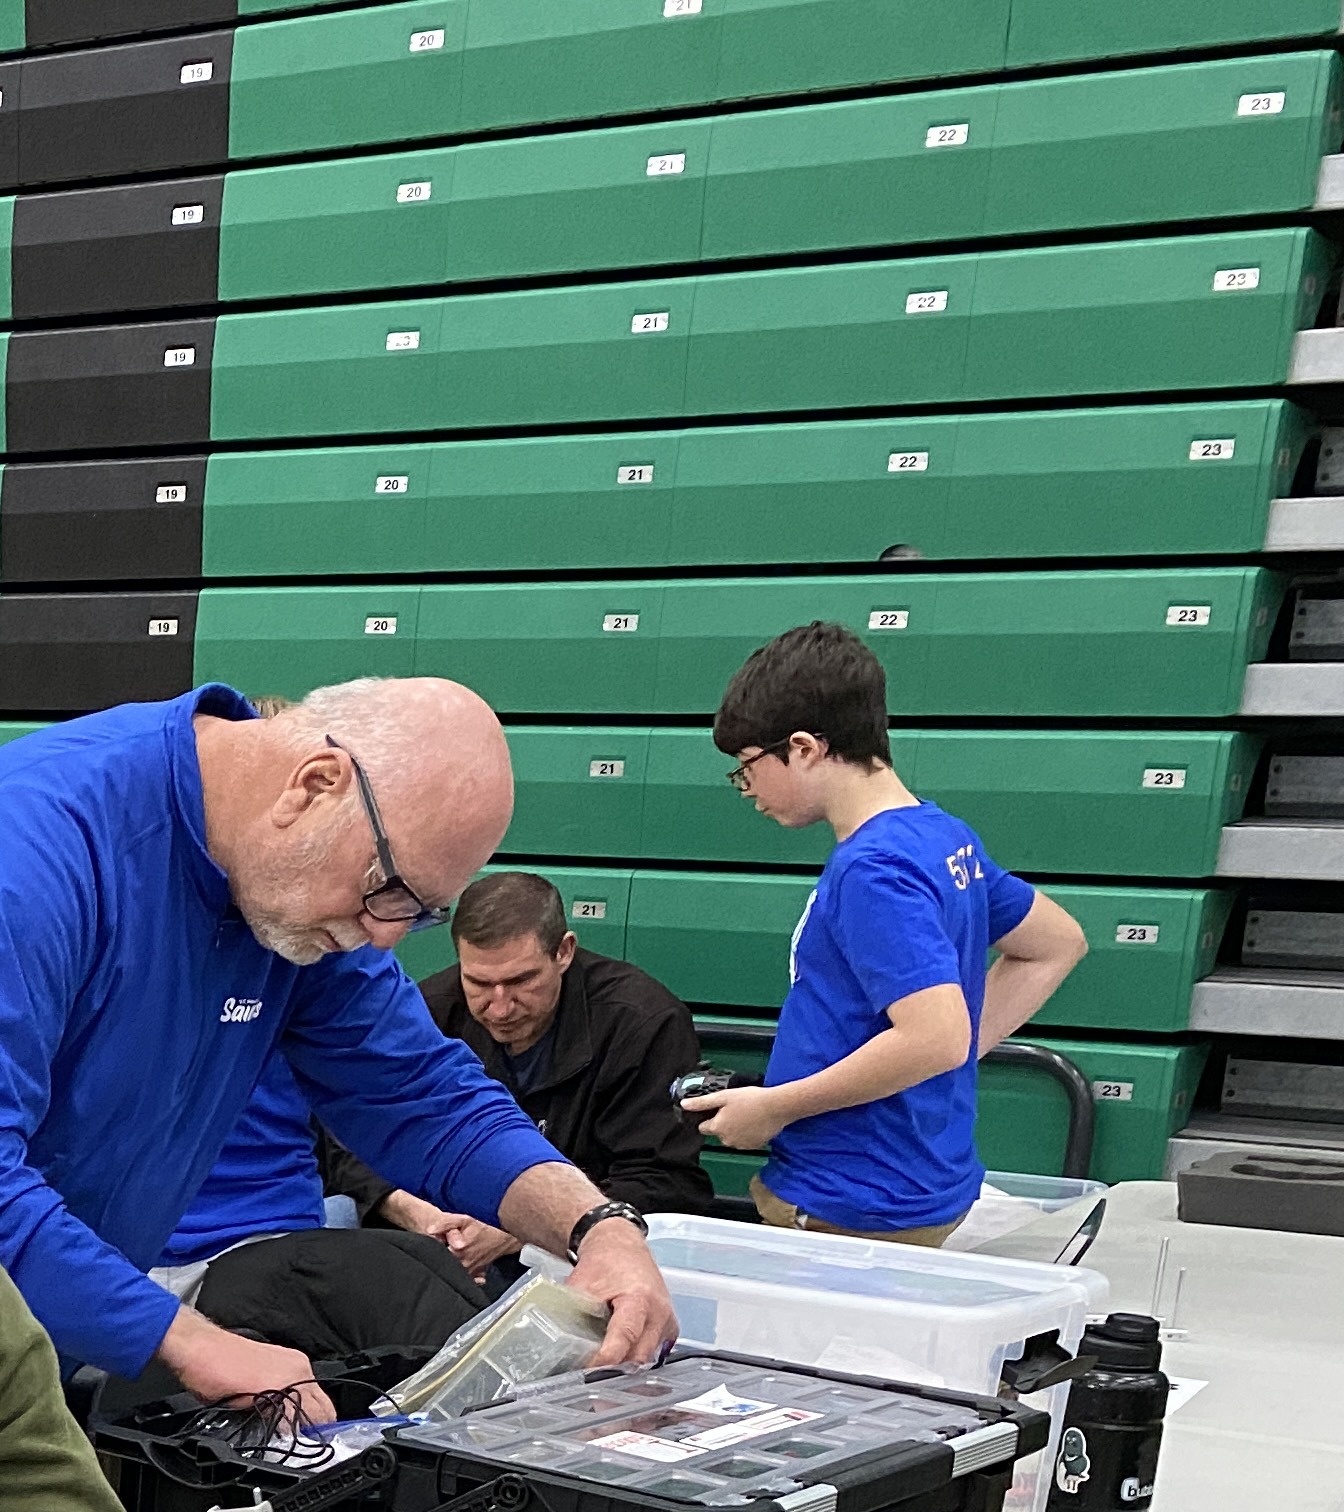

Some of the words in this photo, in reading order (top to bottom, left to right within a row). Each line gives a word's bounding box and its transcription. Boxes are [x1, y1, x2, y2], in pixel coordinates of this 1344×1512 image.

[419, 34, 434, 47] 20
[191, 67, 203, 79] 19
[1251, 97, 1271, 111] 23
[938, 129, 957, 142] 22
[406, 186, 422, 198] 20
[182, 210, 194, 220] 19
[1226, 273, 1247, 286] 23
[643, 317, 658, 329] 21
[174, 352, 186, 362] 19
[1201, 443, 1222, 456] 23
[899, 456, 917, 468] 22
[628, 469, 643, 481] 21
[384, 479, 399, 490] 20
[166, 489, 178, 499] 19
[879, 614, 898, 626] 22
[1178, 610, 1198, 622] 23
[158, 622, 170, 633] 19
[374, 620, 388, 631] 20
[613, 617, 628, 629] 21
[600, 763, 614, 774] 21
[1154, 772, 1174, 785] 23
[582, 904, 597, 916] 21
[1127, 928, 1146, 940] 23
[1102, 1085, 1120, 1097] 23
